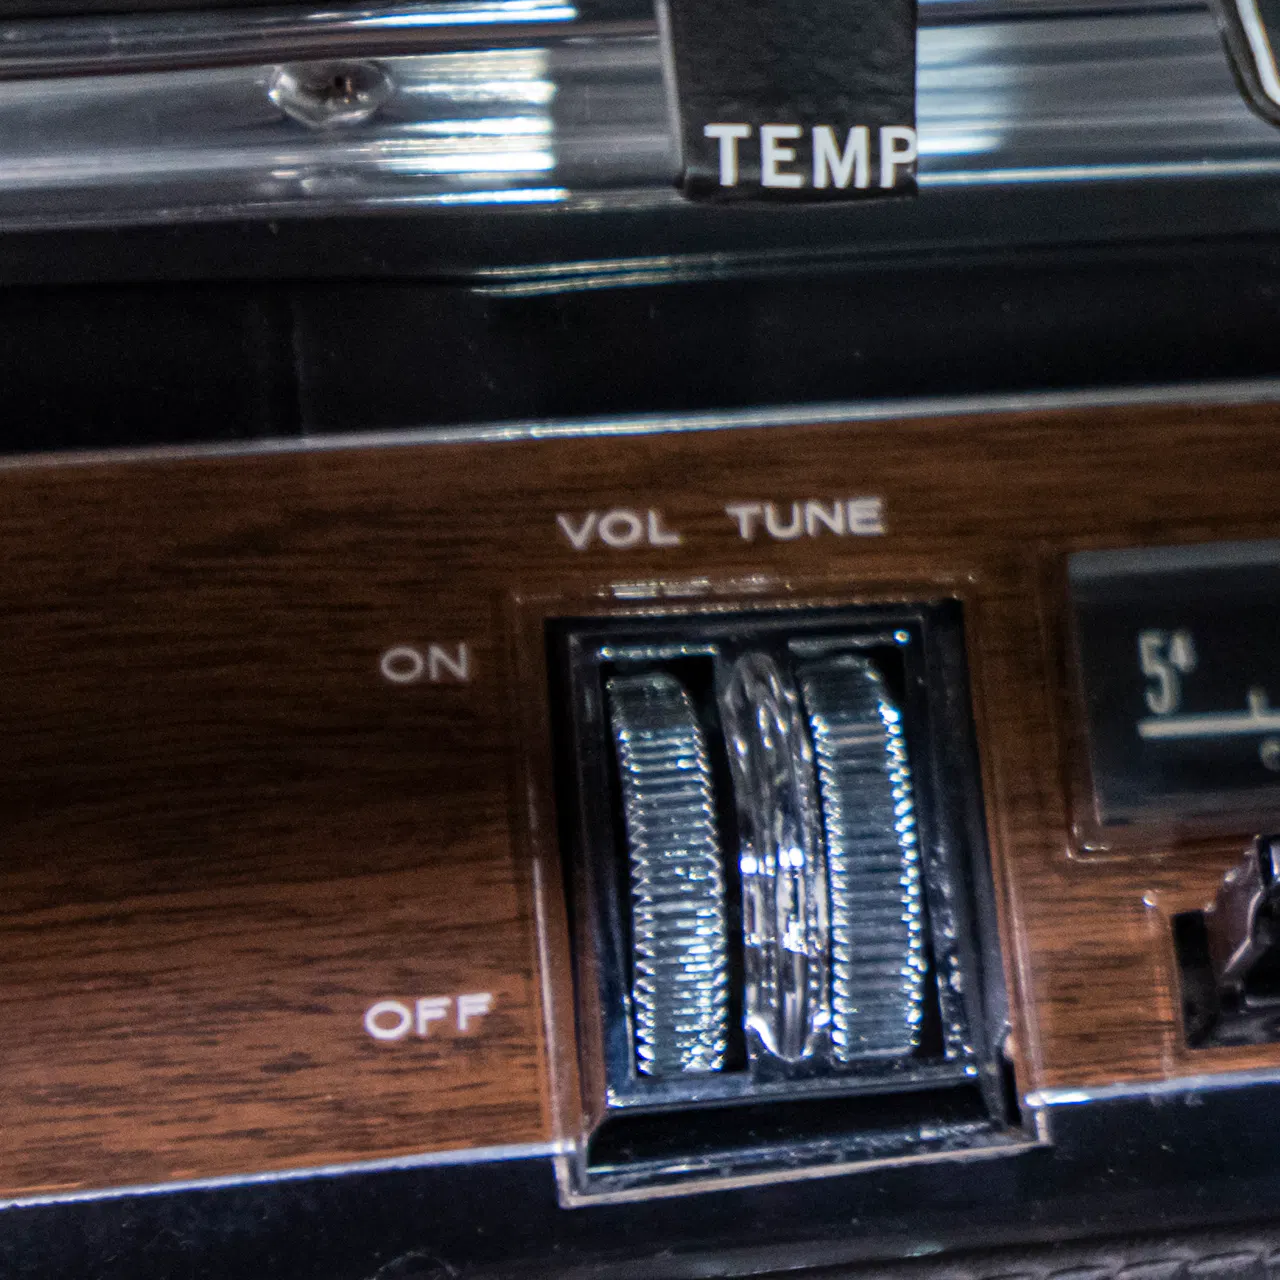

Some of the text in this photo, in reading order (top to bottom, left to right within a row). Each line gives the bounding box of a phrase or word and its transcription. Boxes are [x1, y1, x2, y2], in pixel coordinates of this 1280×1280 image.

[704, 123, 918, 189] TEMP
[558, 497, 888, 550] VOL TUNE
[381, 643, 471, 682] ON
[364, 993, 492, 1041] OFF
